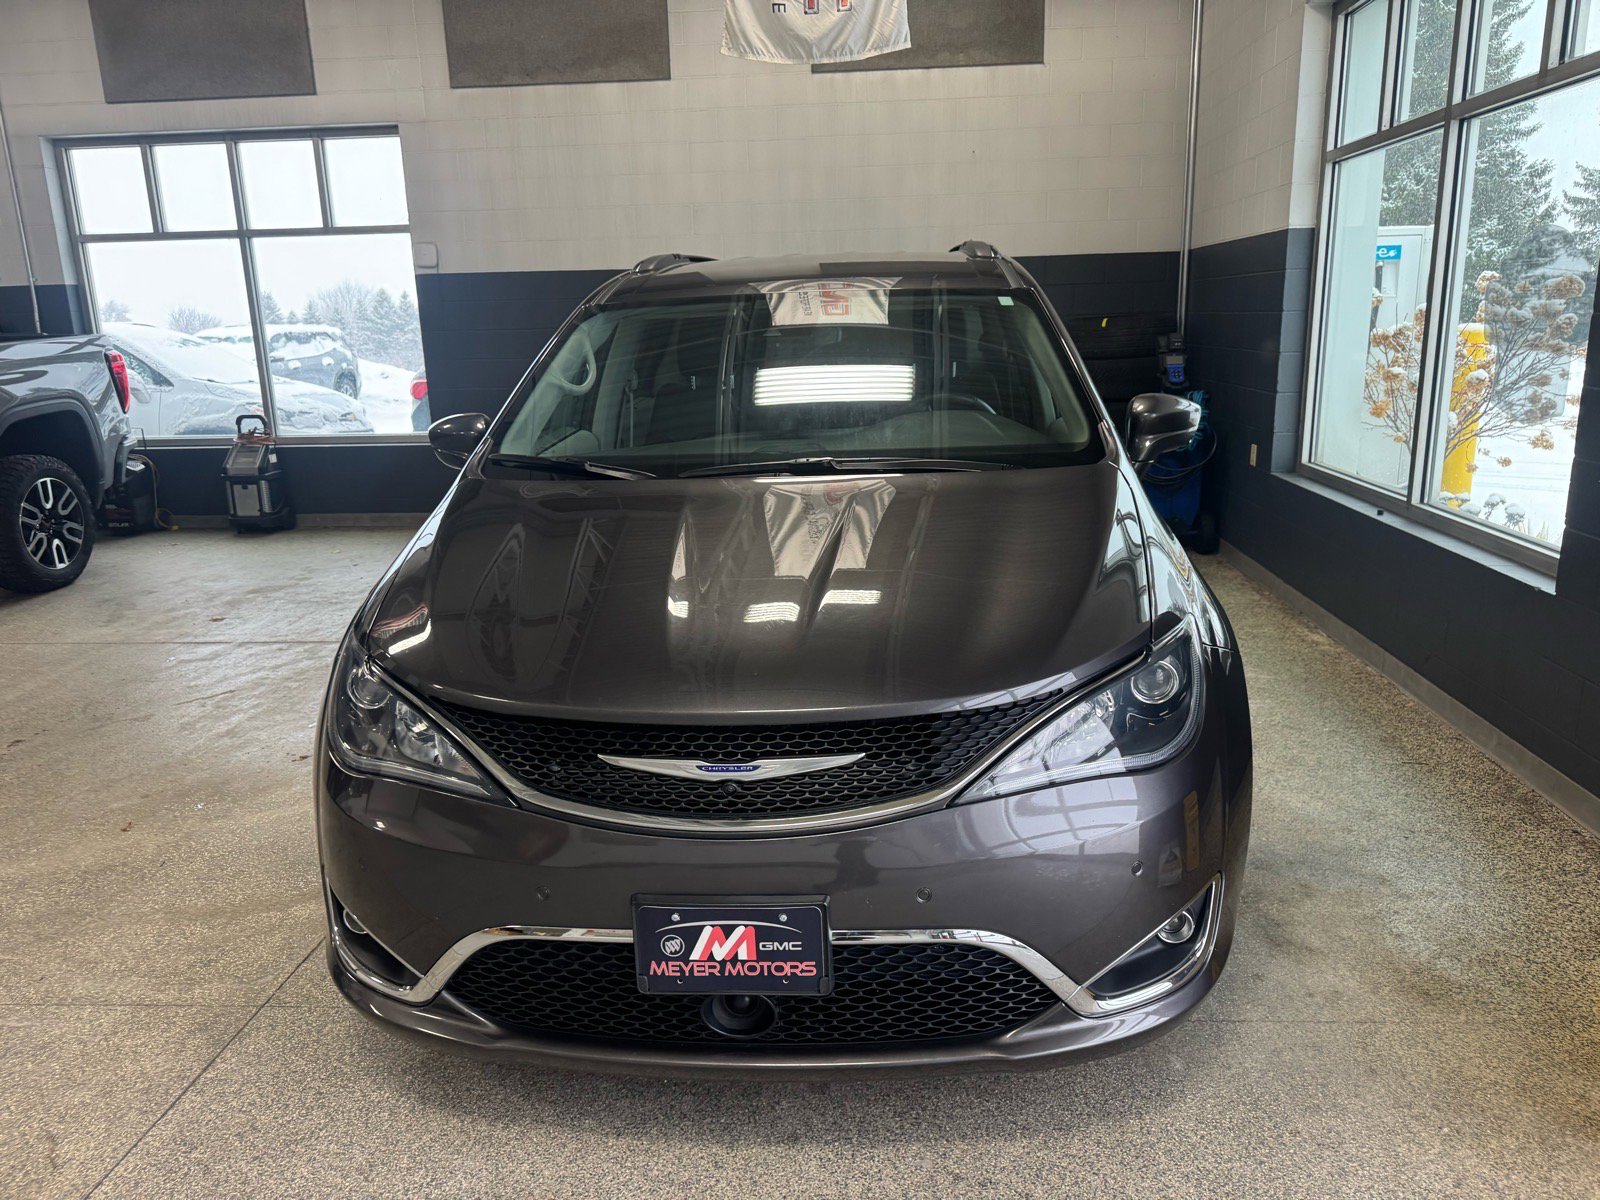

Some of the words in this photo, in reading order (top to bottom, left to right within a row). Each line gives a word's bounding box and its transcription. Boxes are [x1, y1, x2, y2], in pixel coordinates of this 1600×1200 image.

[759, 941, 802, 951] GMC
[649, 960, 721, 976] MEYER
[724, 961, 817, 976] MOTORS
